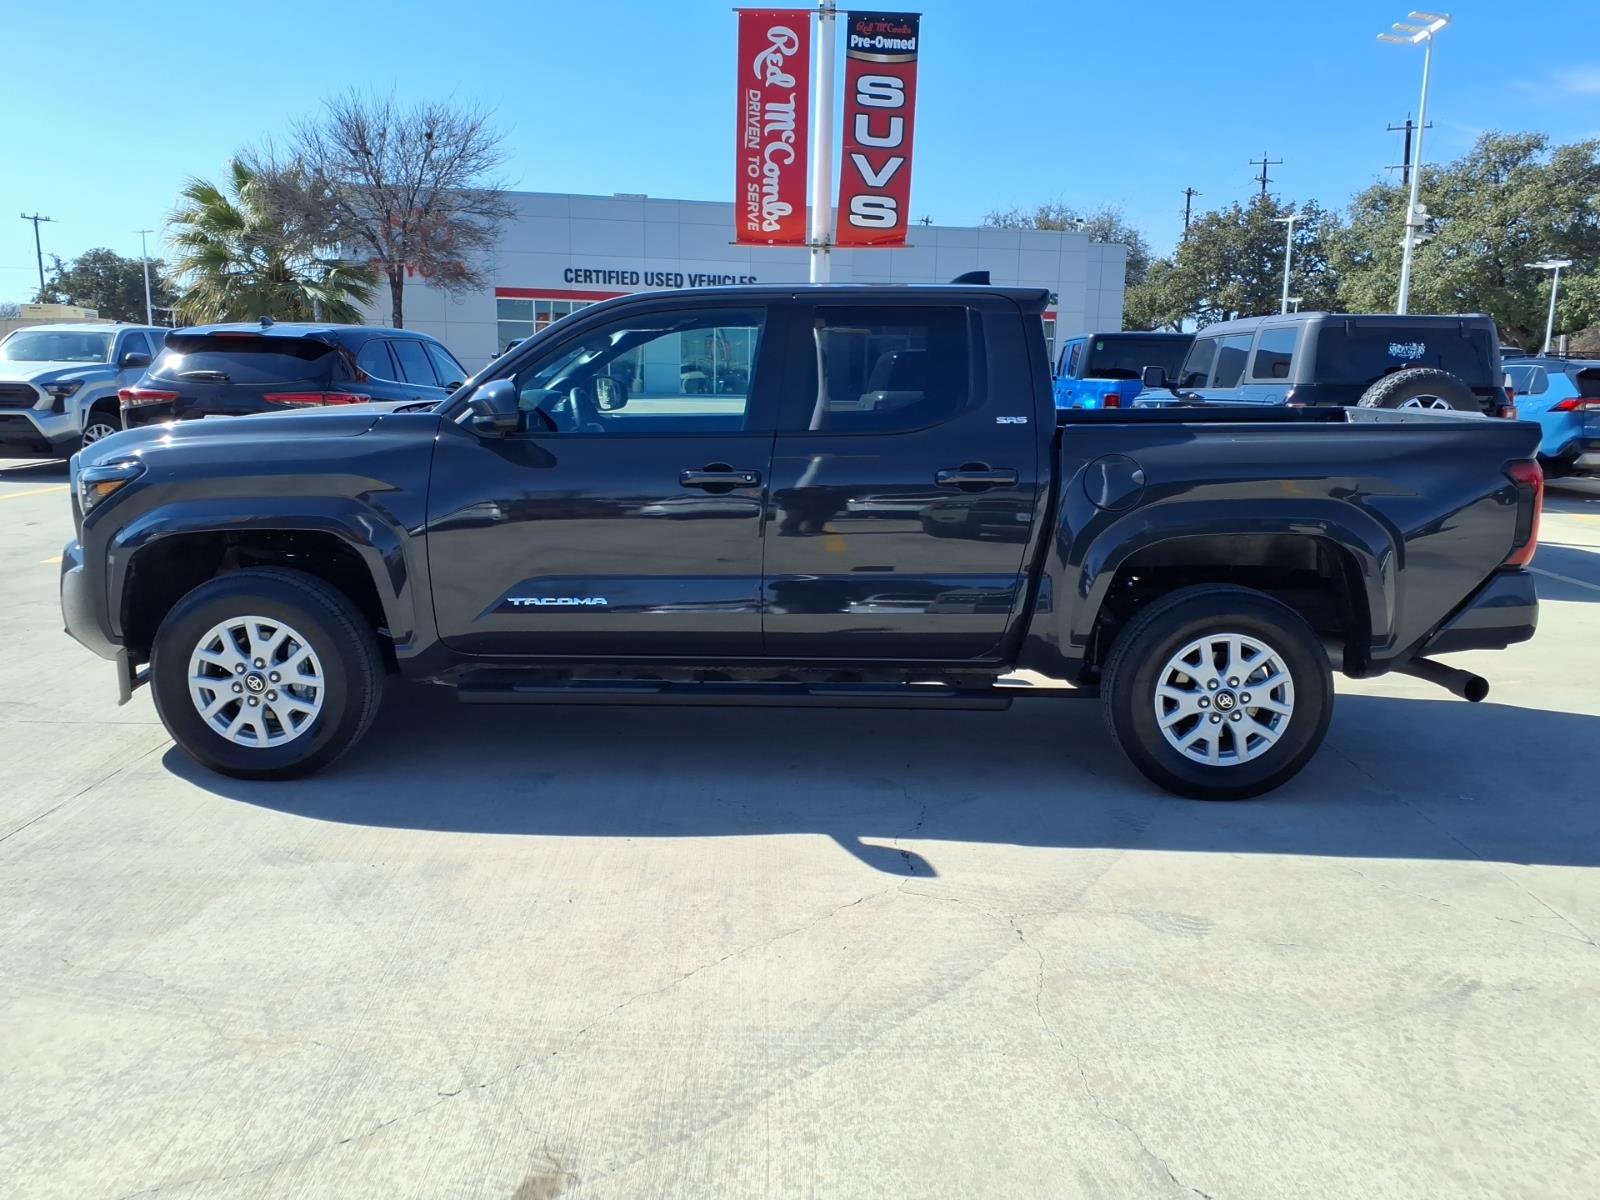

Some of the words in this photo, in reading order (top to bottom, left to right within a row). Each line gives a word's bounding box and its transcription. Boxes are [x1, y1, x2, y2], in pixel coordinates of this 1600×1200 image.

[753, 26, 799, 87] Red
[850, 35, 916, 50] Pre-Owned
[747, 89, 761, 149] DRIVEN
[747, 155, 760, 178] TO
[762, 93, 796, 232] McCombs
[849, 75, 905, 228] SUVS
[747, 183, 760, 232] SERVE
[564, 268, 640, 286] CERTIFIED
[644, 272, 684, 289] USED
[507, 597, 608, 606] TACOMA
